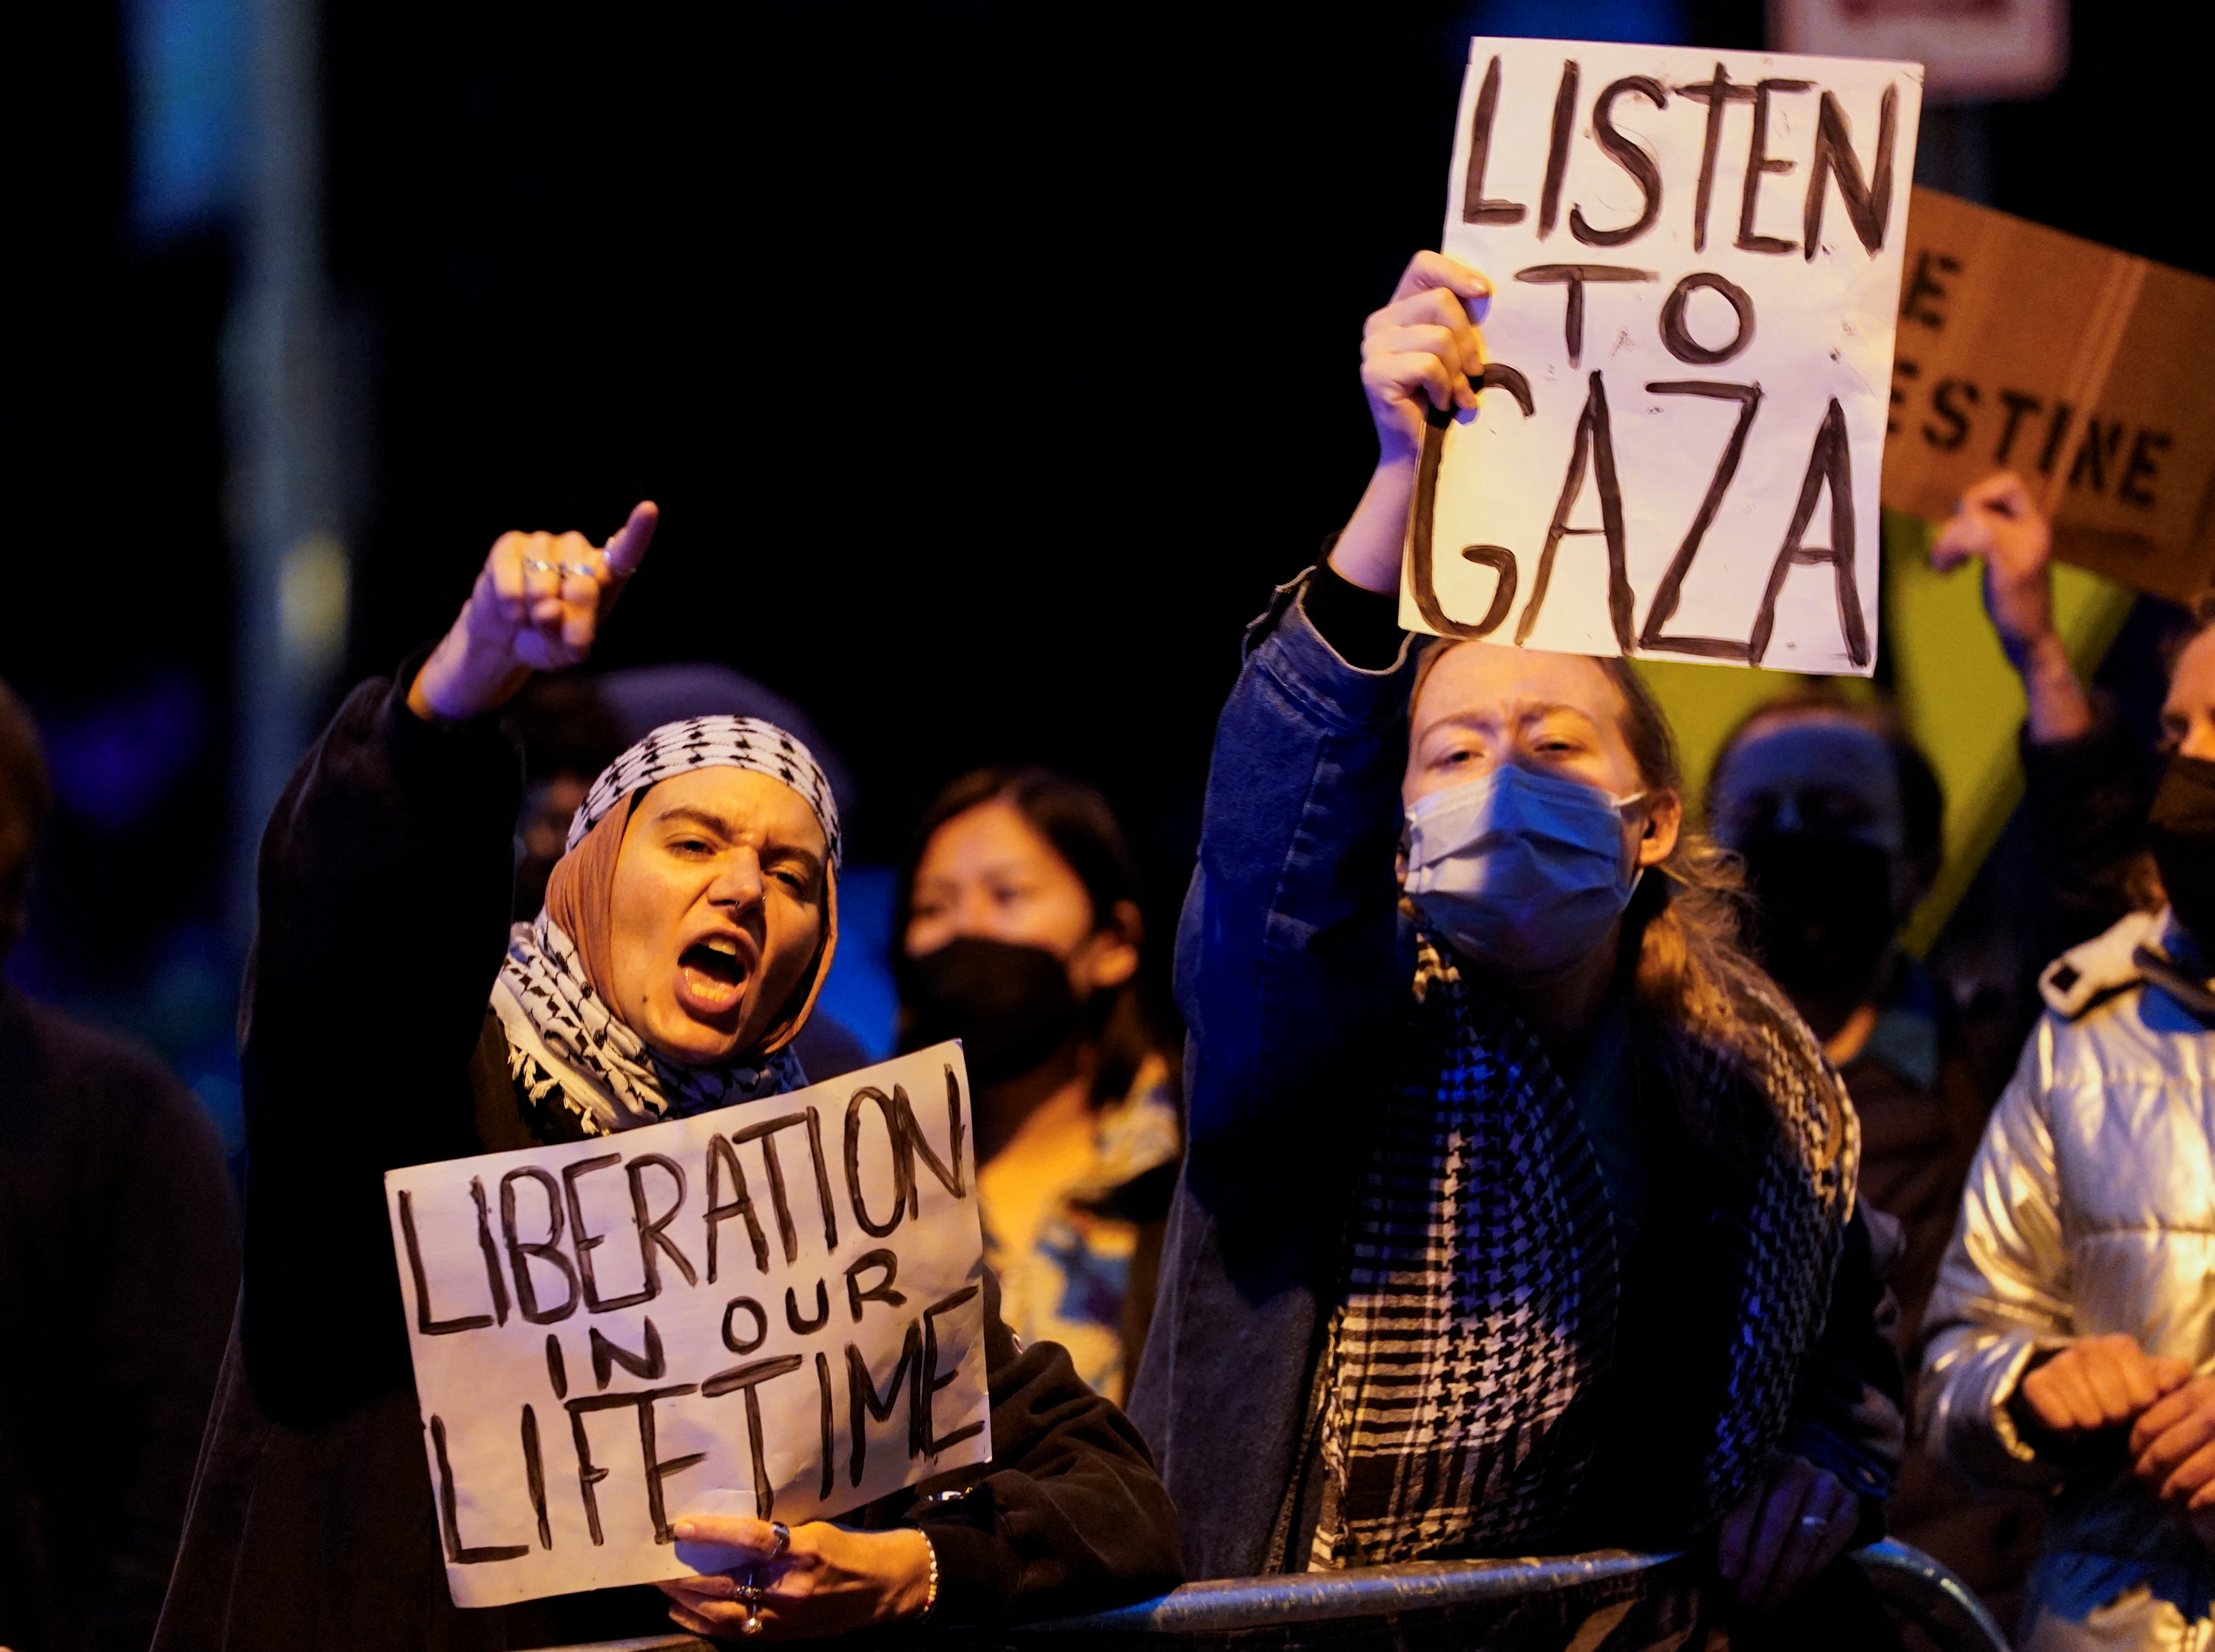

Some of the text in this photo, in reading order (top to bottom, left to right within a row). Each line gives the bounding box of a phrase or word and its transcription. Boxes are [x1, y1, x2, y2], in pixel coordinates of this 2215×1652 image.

[1463, 54, 1898, 263] LISTEN
[1513, 263, 1756, 368] TO
[1410, 363, 1871, 670] GAZA
[398, 1063, 966, 1335] LIBERATION
[429, 1286, 985, 1563] LIFETIME
[545, 1248, 909, 1400] IN OUR
